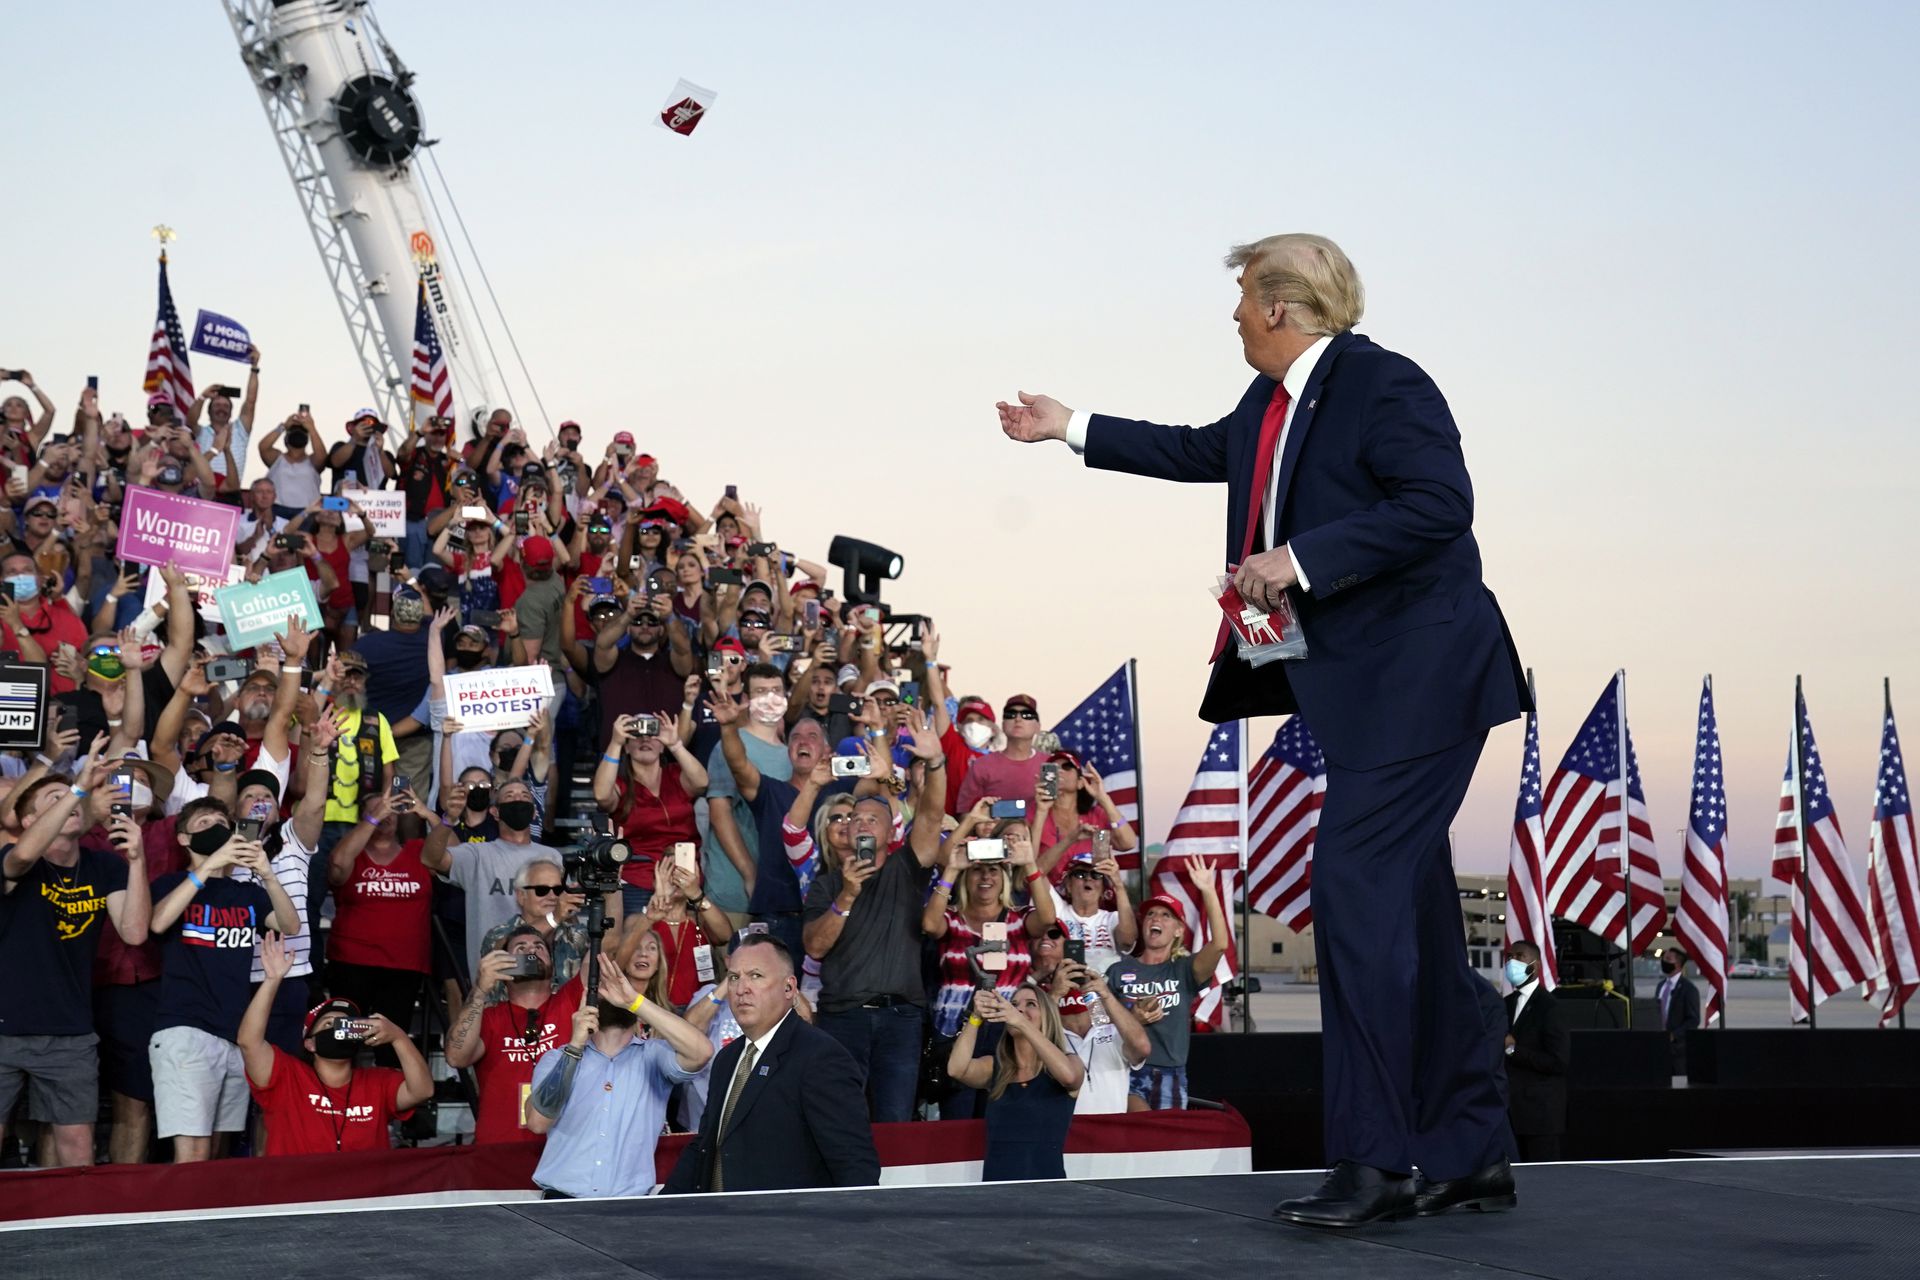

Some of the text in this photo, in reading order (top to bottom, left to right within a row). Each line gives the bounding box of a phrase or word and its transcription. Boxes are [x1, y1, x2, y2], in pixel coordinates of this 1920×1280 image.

[421, 261, 447, 314] Sims
[203, 322, 214, 333] 4
[203, 334, 248, 353] YEARS!
[136, 508, 221, 547] Women
[141, 533, 210, 554] FOR TRUMP
[230, 590, 301, 618] Latinos
[240, 617, 263, 630] FOR
[459, 677, 539, 690] THIS IS A
[458, 686, 542, 701] PEACEFUL
[460, 697, 543, 717] PROTEST
[355, 881, 421, 893] TRUMP
[1120, 978, 1180, 995] TRUMP
[308, 1093, 374, 1117] TRMP
